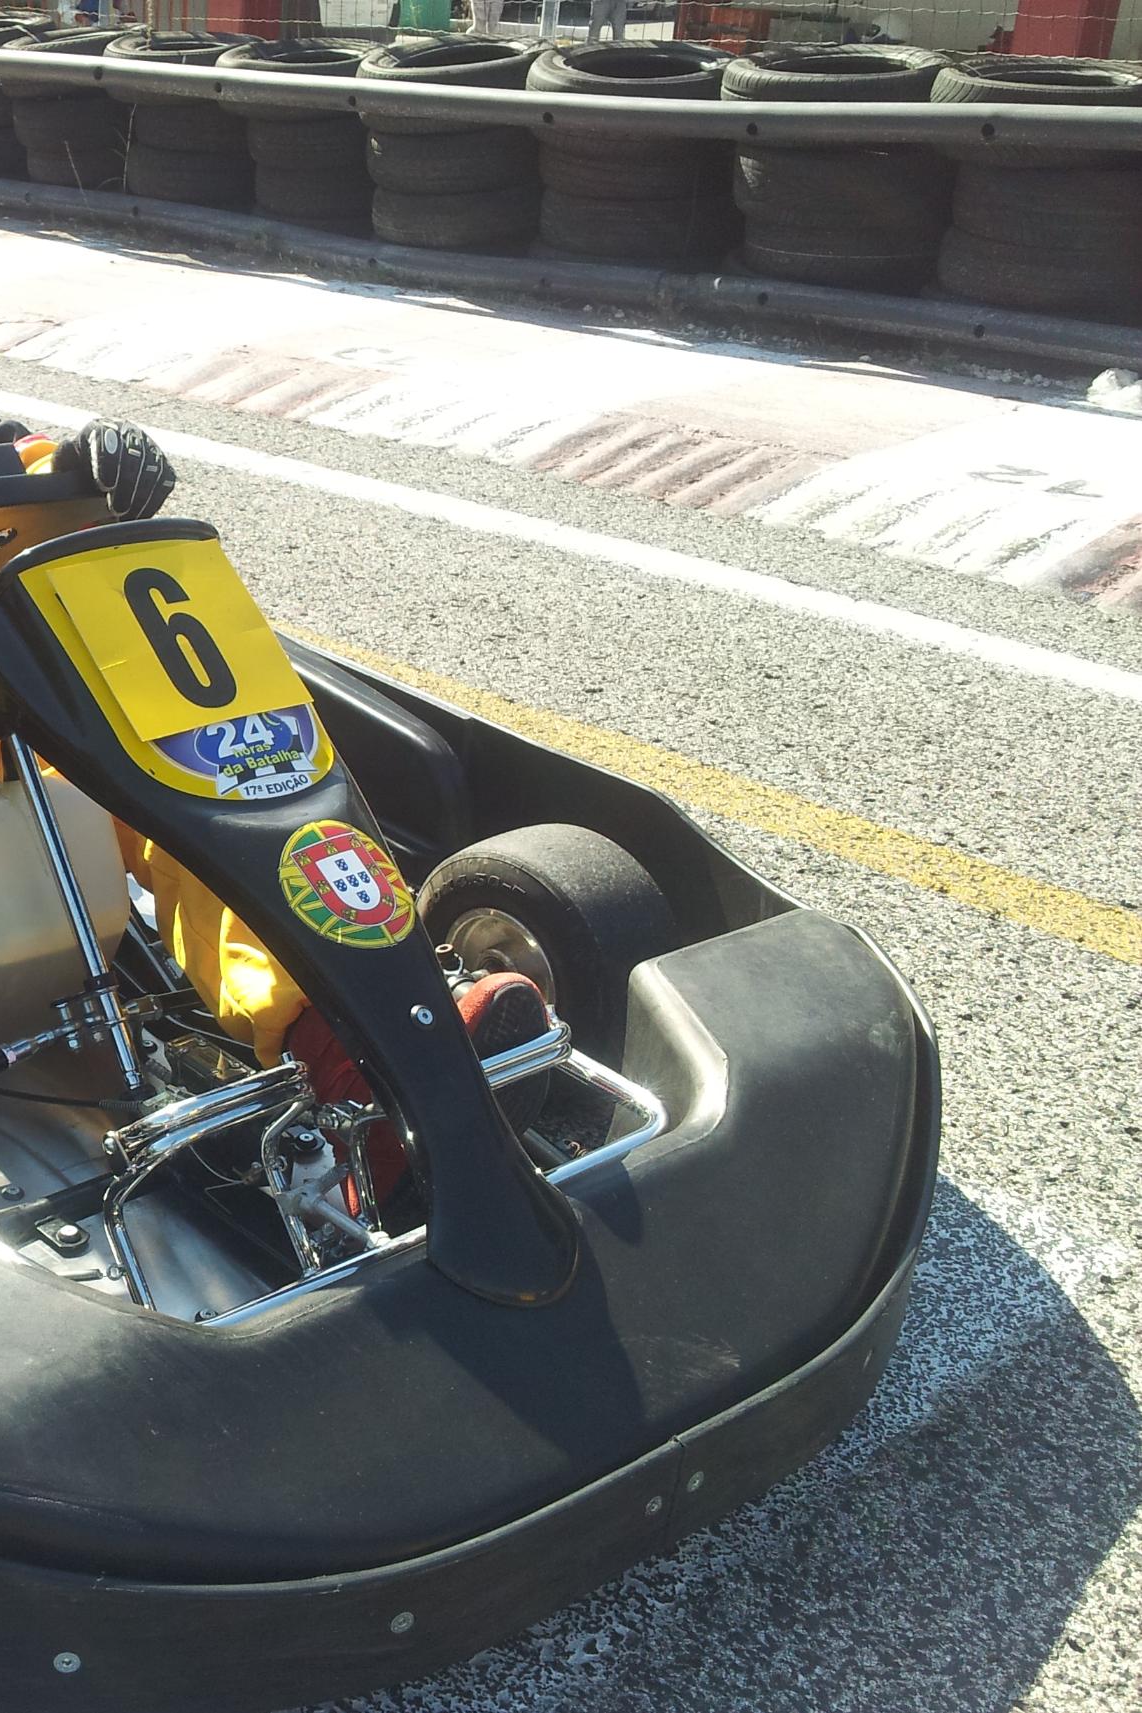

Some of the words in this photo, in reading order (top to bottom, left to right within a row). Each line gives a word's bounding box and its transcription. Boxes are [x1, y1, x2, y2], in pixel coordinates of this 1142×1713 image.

[123, 567, 237, 708] 6
[206, 714, 275, 759] 24
[223, 763, 245, 777] da
[245, 749, 300, 770] Batalha
[265, 774, 309, 795] EDIÇÃO
